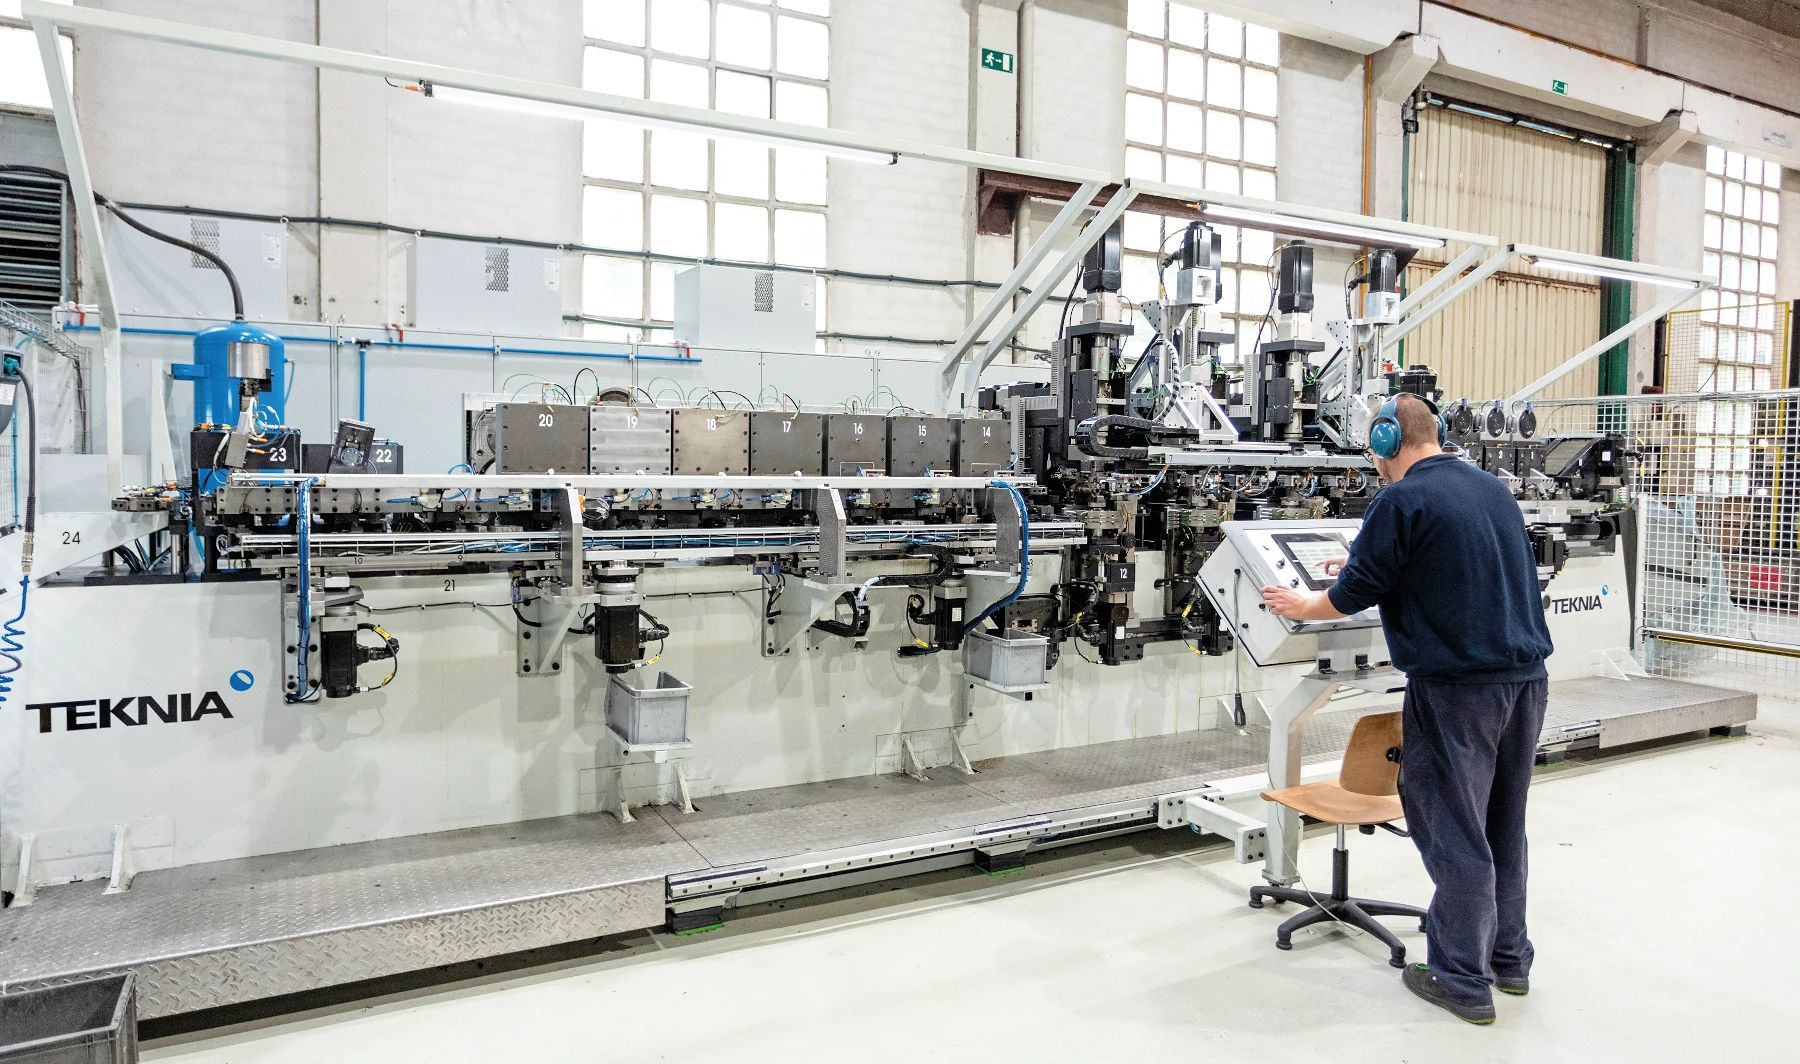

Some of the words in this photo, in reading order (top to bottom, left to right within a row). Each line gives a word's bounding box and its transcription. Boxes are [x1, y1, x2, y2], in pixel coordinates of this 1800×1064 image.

[538, 414, 553, 428] 20
[626, 416, 638, 429] 19
[706, 418, 717, 431] 18
[782, 421, 793, 433] 17
[853, 422, 864, 434] 16
[917, 425, 927, 437] 15
[982, 427, 991, 438] 14
[269, 448, 287, 462] 23
[376, 448, 392, 462] 22
[62, 531, 81, 545] 24
[1120, 568, 1128, 579] 12
[444, 580, 456, 592] 21
[1551, 594, 1603, 614] TEKNIA
[25, 691, 234, 734] TEKNIA
